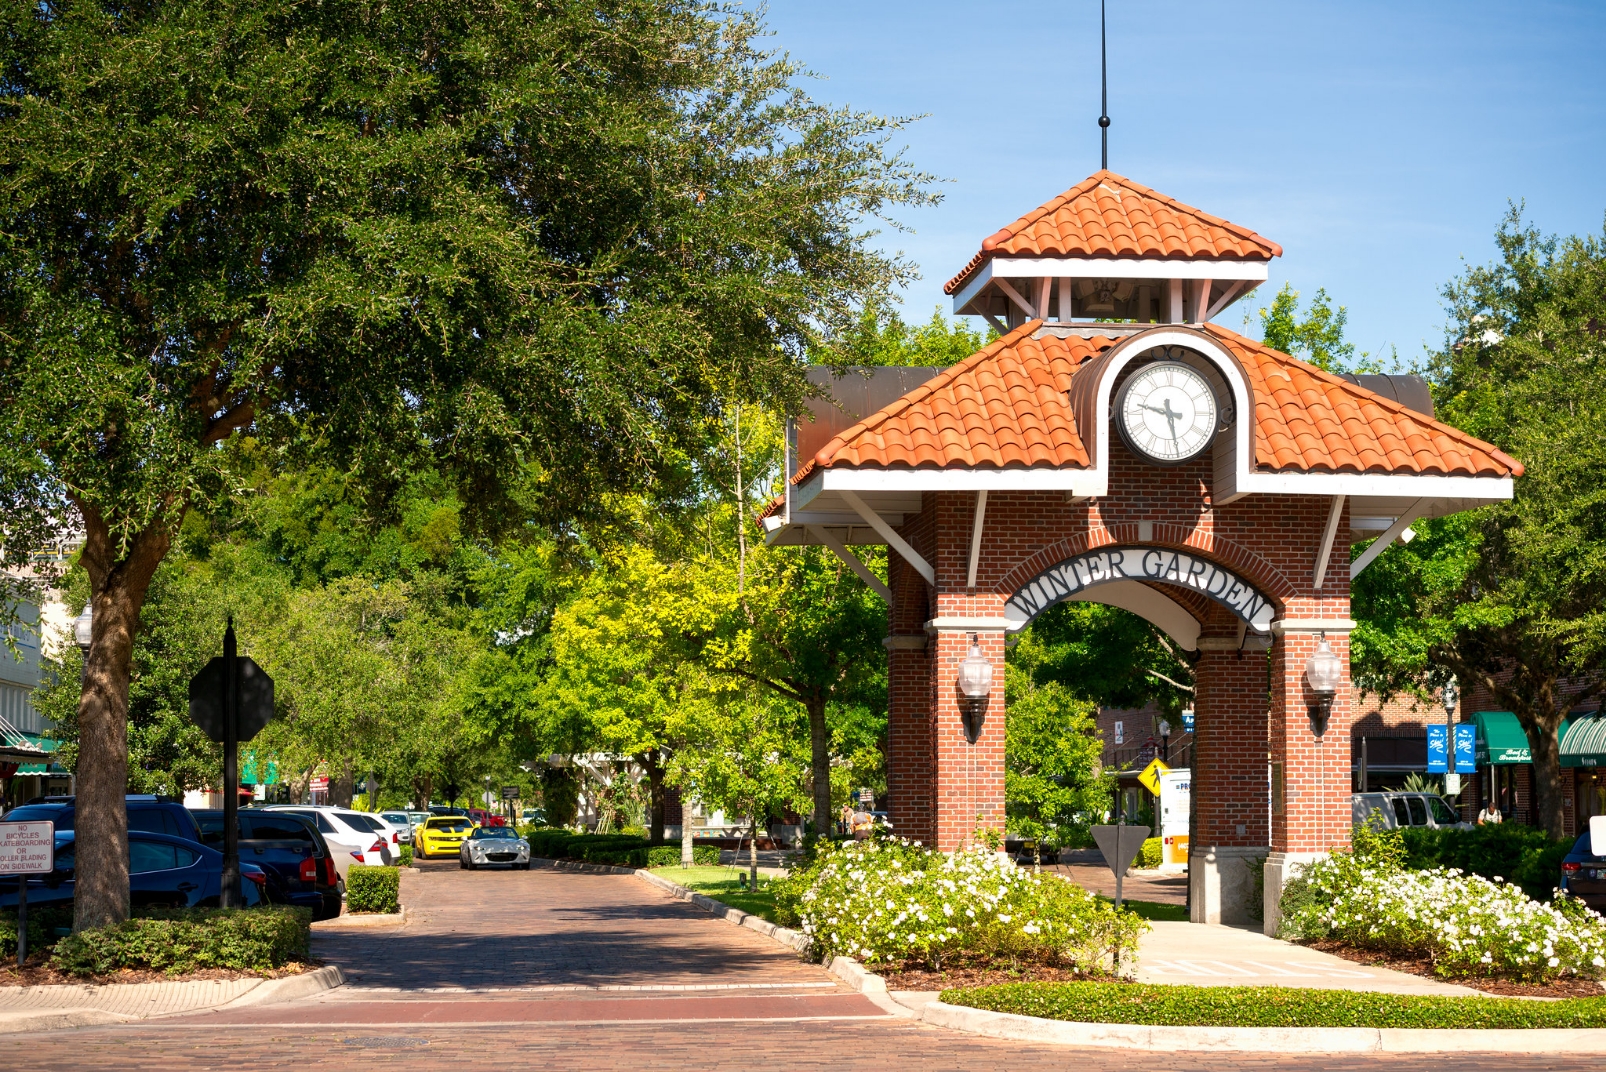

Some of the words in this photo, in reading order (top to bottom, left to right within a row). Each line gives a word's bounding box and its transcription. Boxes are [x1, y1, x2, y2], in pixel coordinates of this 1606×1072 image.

[1011, 550, 1129, 618] WINTER
[1142, 549, 1269, 622] GARDEN
[1143, 959, 1376, 979] STOP
